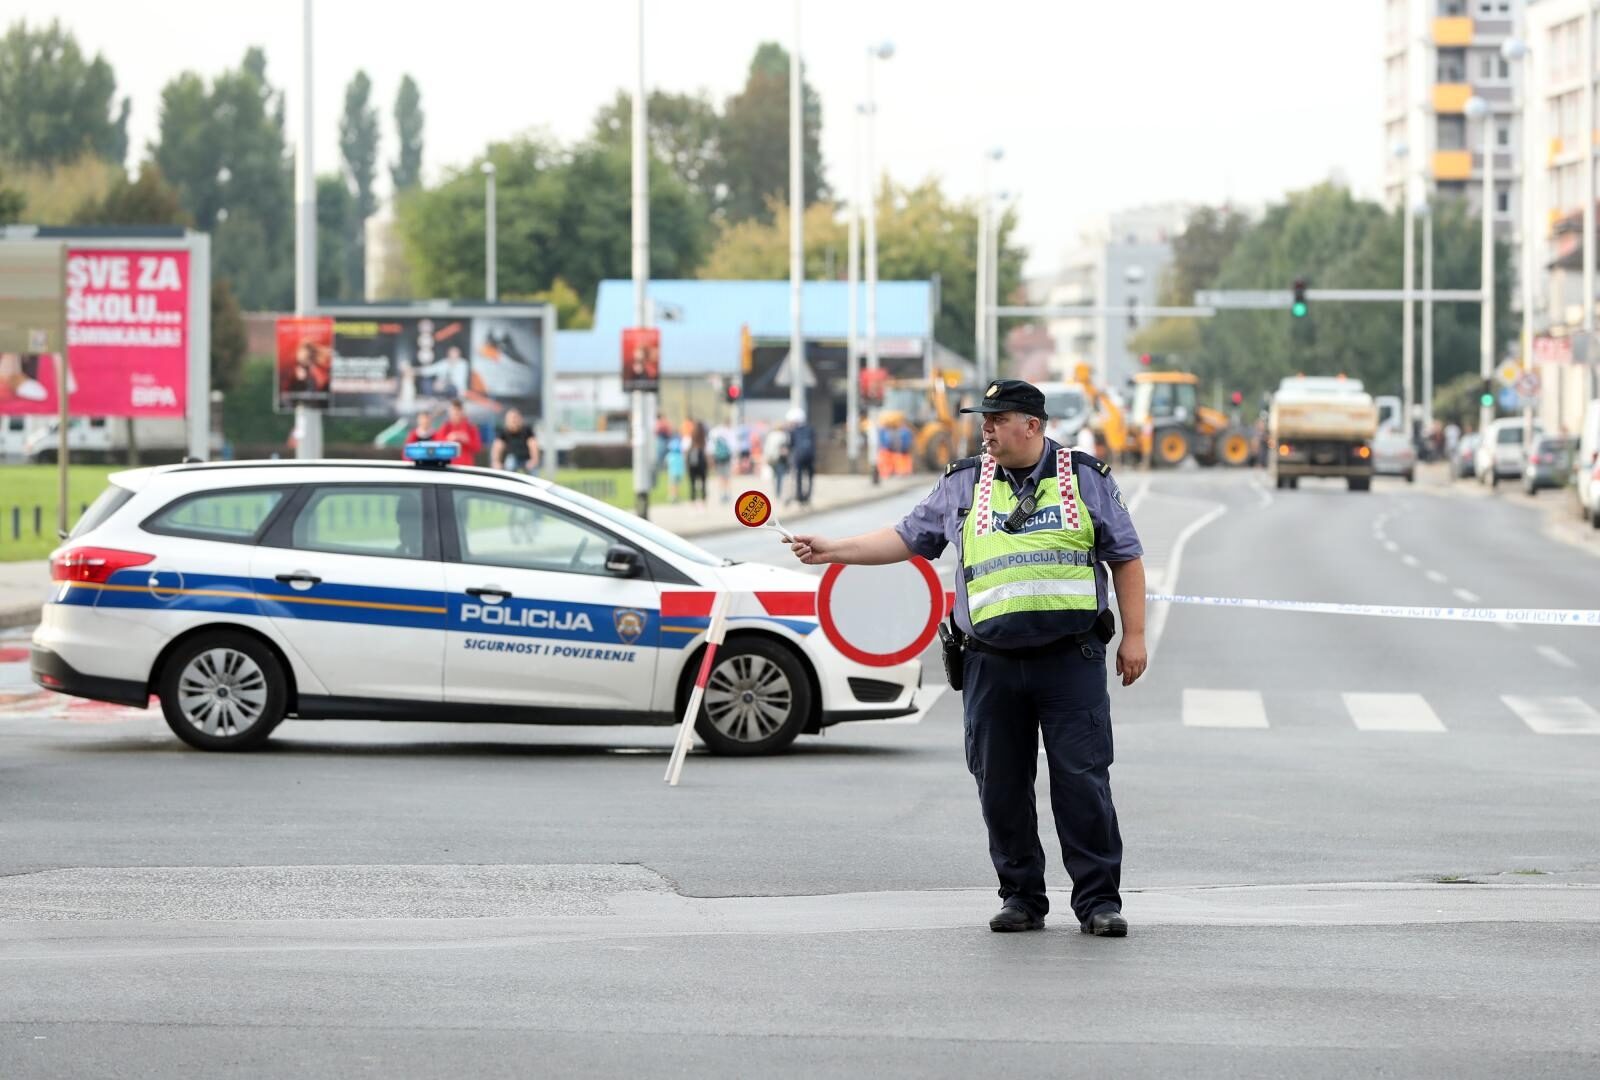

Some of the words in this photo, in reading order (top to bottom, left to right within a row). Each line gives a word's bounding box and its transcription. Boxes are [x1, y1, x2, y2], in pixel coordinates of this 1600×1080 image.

[68, 257, 130, 290] SVE
[137, 257, 181, 290] ZA
[131, 386, 177, 407] BIPA
[742, 496, 758, 519] STOP
[748, 501, 765, 521] POLICIJA
[992, 511, 1058, 529] PCIJA
[1008, 552, 1056, 566] POLICIJA
[460, 603, 593, 632] POLICIJA
[464, 638, 541, 655] SIGURNOST
[544, 646, 550, 656] I
[552, 646, 636, 662] POVJERENJE
